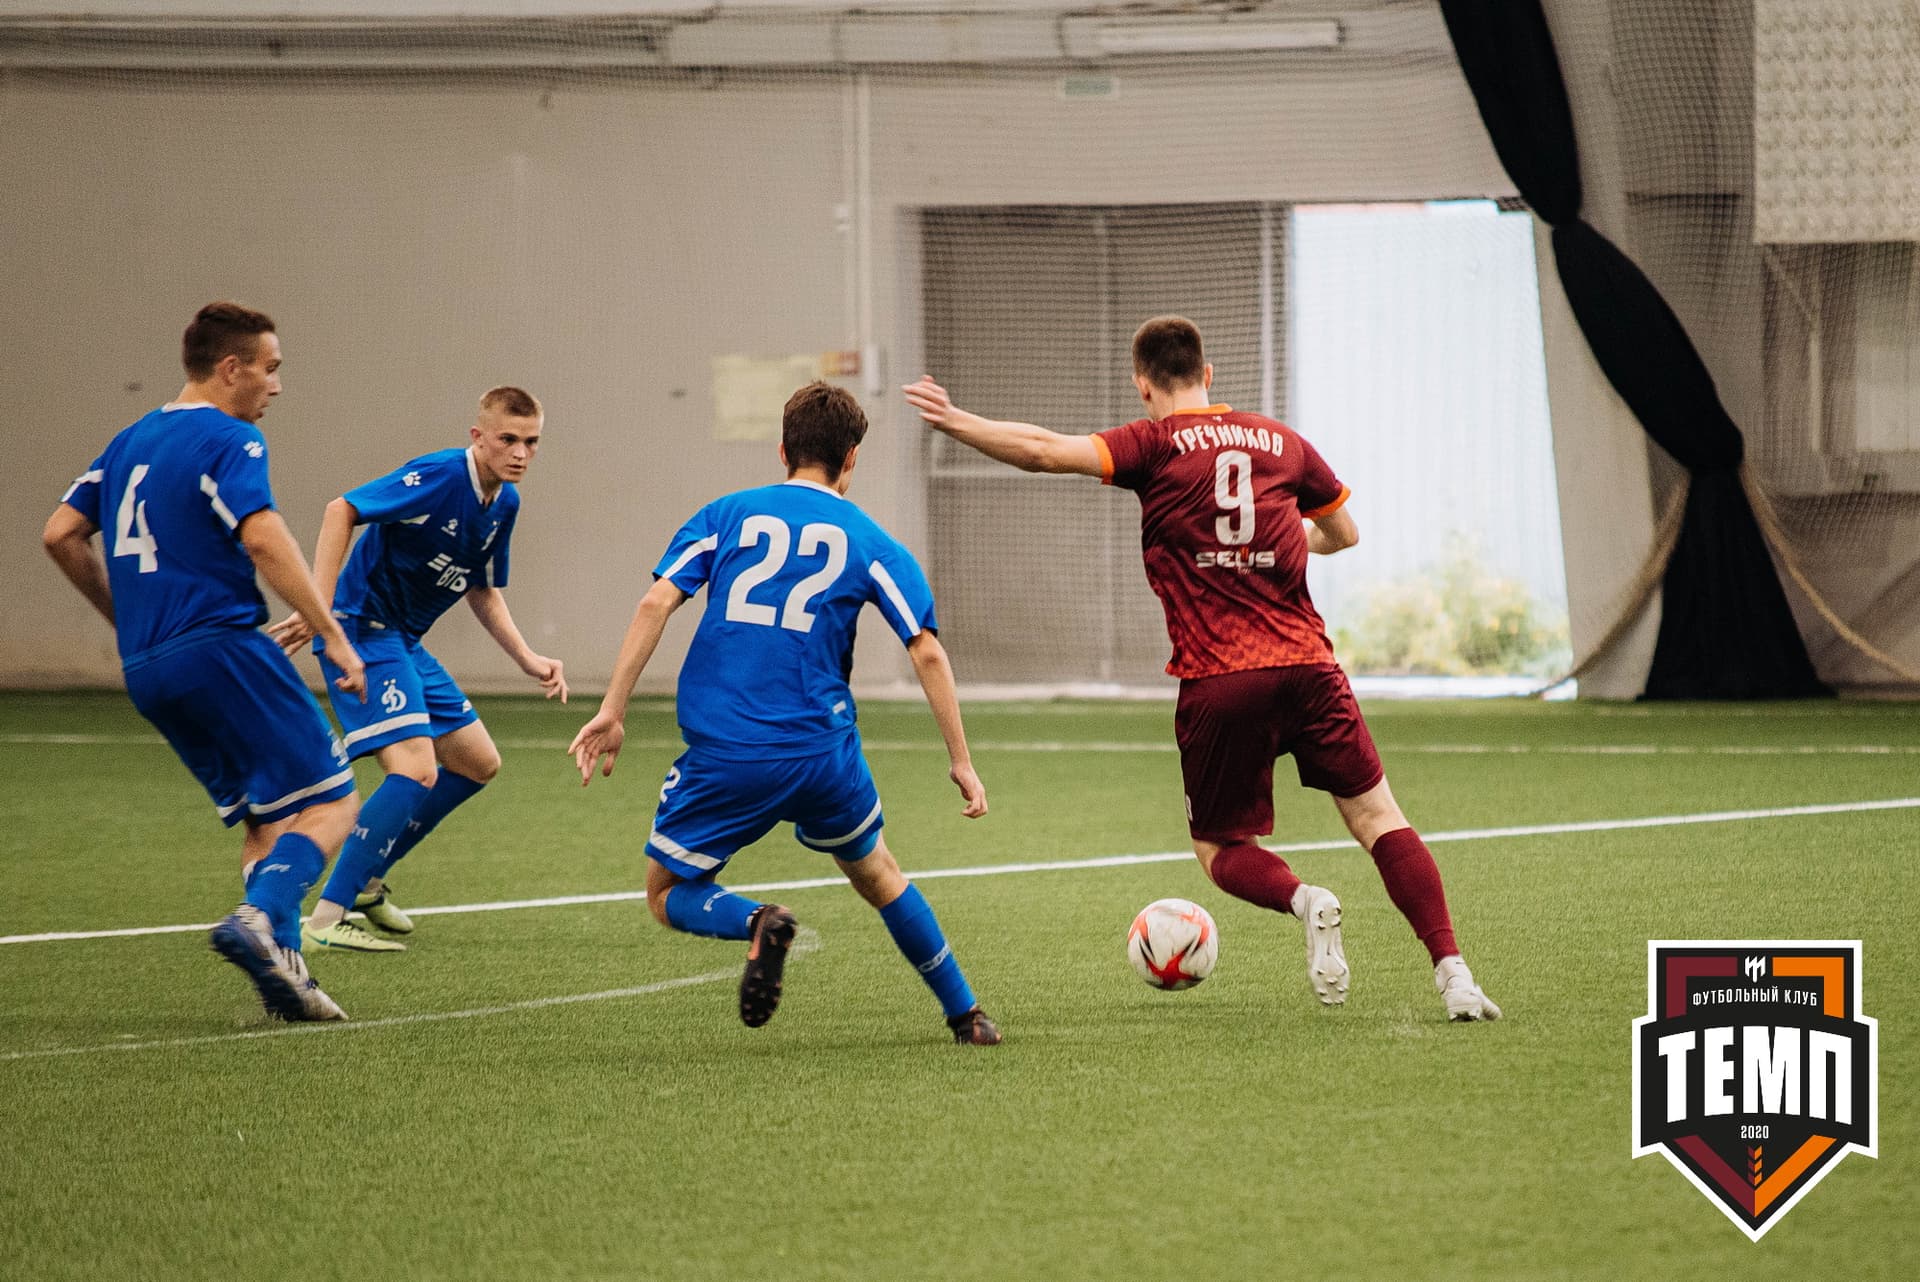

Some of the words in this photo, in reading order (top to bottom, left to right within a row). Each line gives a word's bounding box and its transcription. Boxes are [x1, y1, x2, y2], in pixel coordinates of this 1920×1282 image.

[112, 464, 158, 574] 4
[1214, 450, 1256, 546] 9
[725, 515, 848, 632] 22
